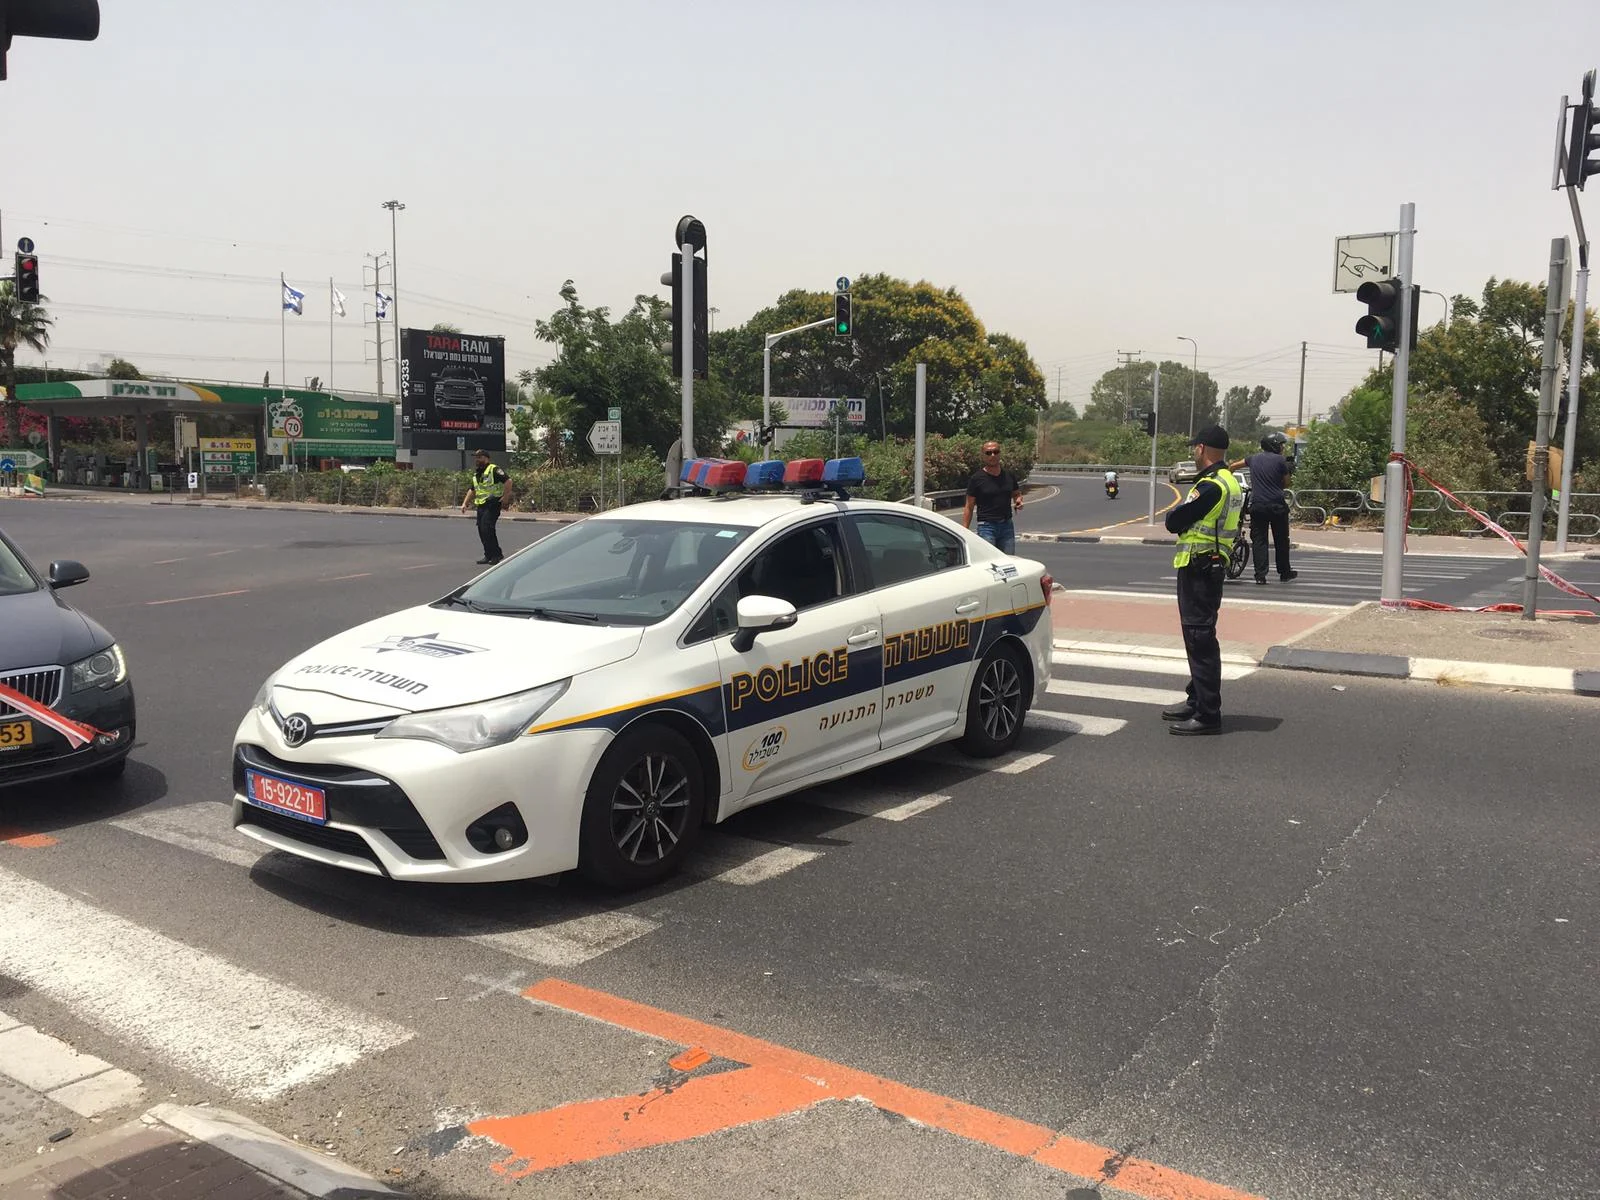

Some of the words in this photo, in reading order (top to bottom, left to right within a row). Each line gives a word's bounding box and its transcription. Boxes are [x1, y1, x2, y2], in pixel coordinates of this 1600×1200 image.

[427, 336, 489, 354] TARARAM
[152, 386, 176, 396] דור
[288, 423, 299, 432] 70
[883, 618, 970, 669] משטרה
[294, 665, 358, 677] POLICE
[731, 645, 849, 711] POLICE
[352, 668, 429, 695] משטרה
[885, 683, 936, 710] משטרת
[819, 701, 877, 731] התנועה
[760, 731, 783, 749] 100
[748, 744, 780, 764] בשבילך
